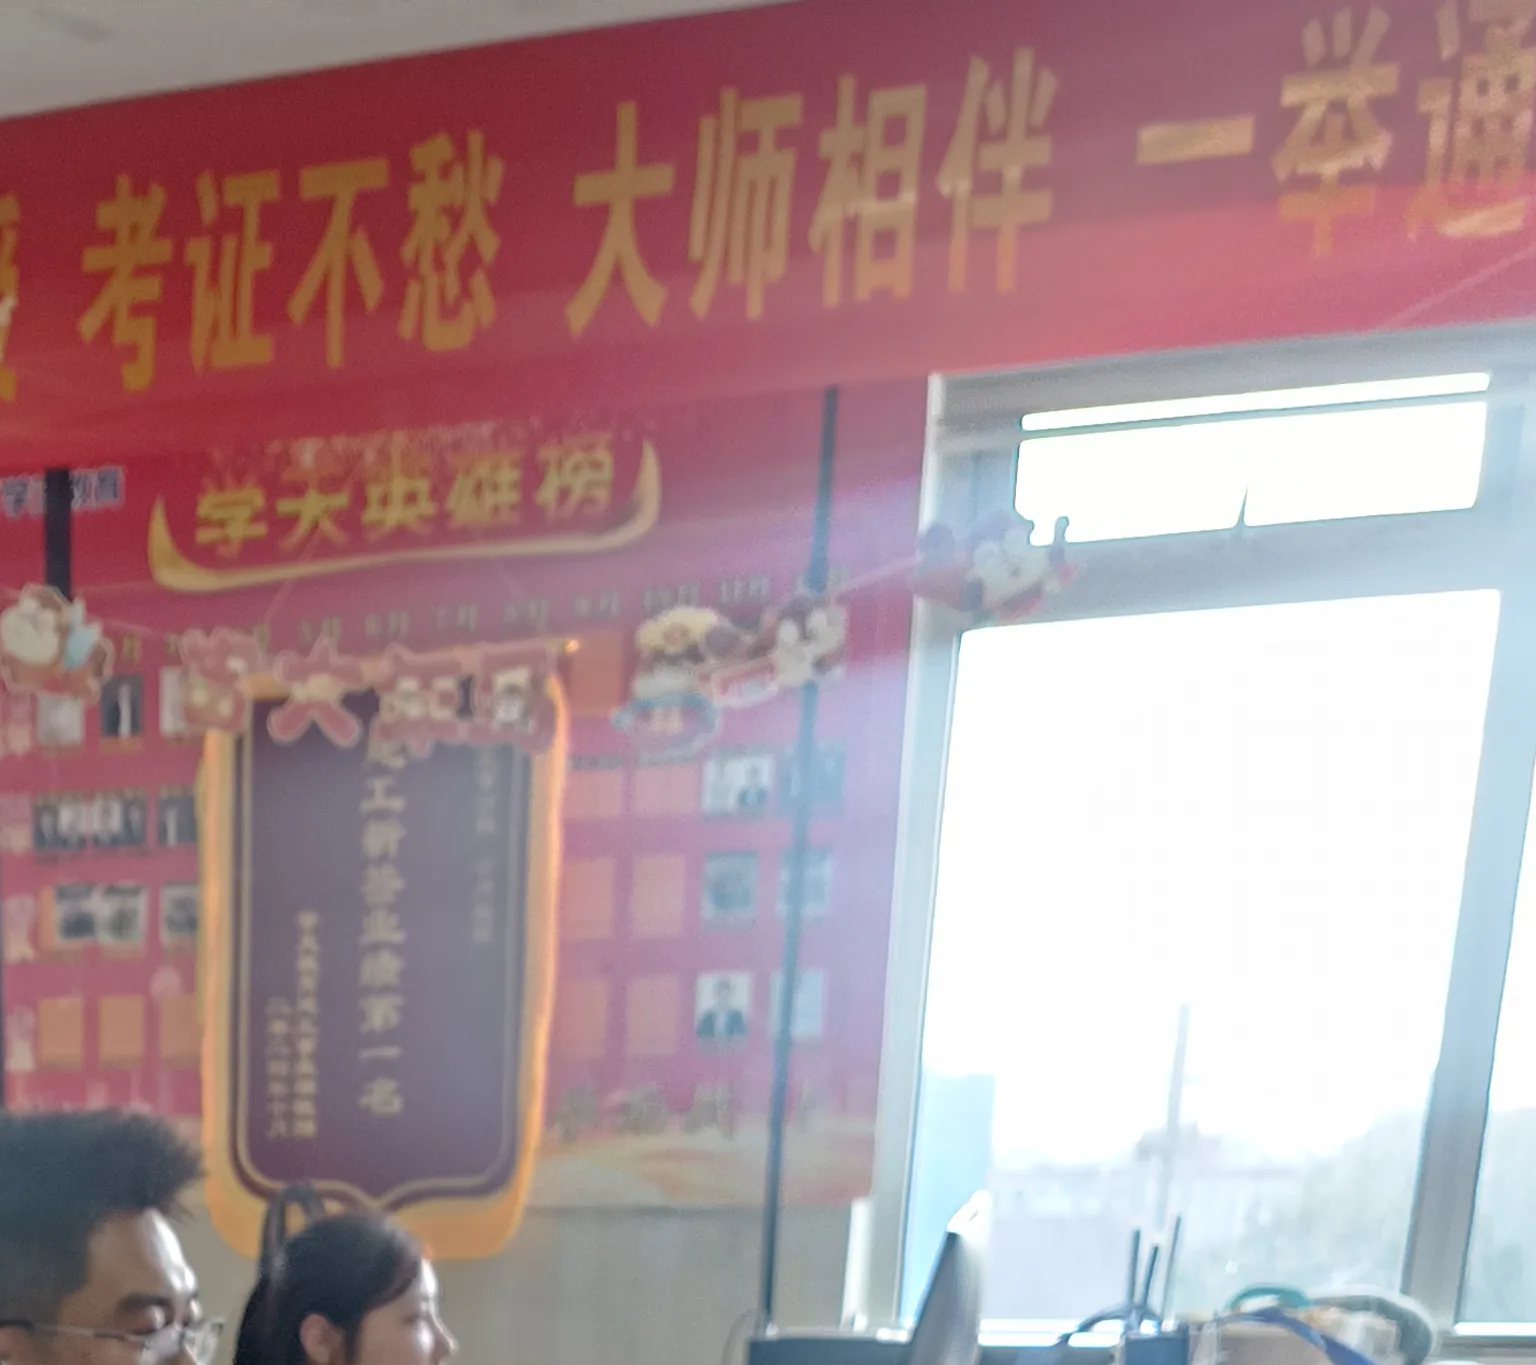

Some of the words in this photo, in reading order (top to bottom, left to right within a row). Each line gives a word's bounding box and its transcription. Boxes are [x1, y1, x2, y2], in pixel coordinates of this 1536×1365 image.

[78, 131, 504, 391] 考证不愁
[564, 47, 1058, 337] 大师相伴
